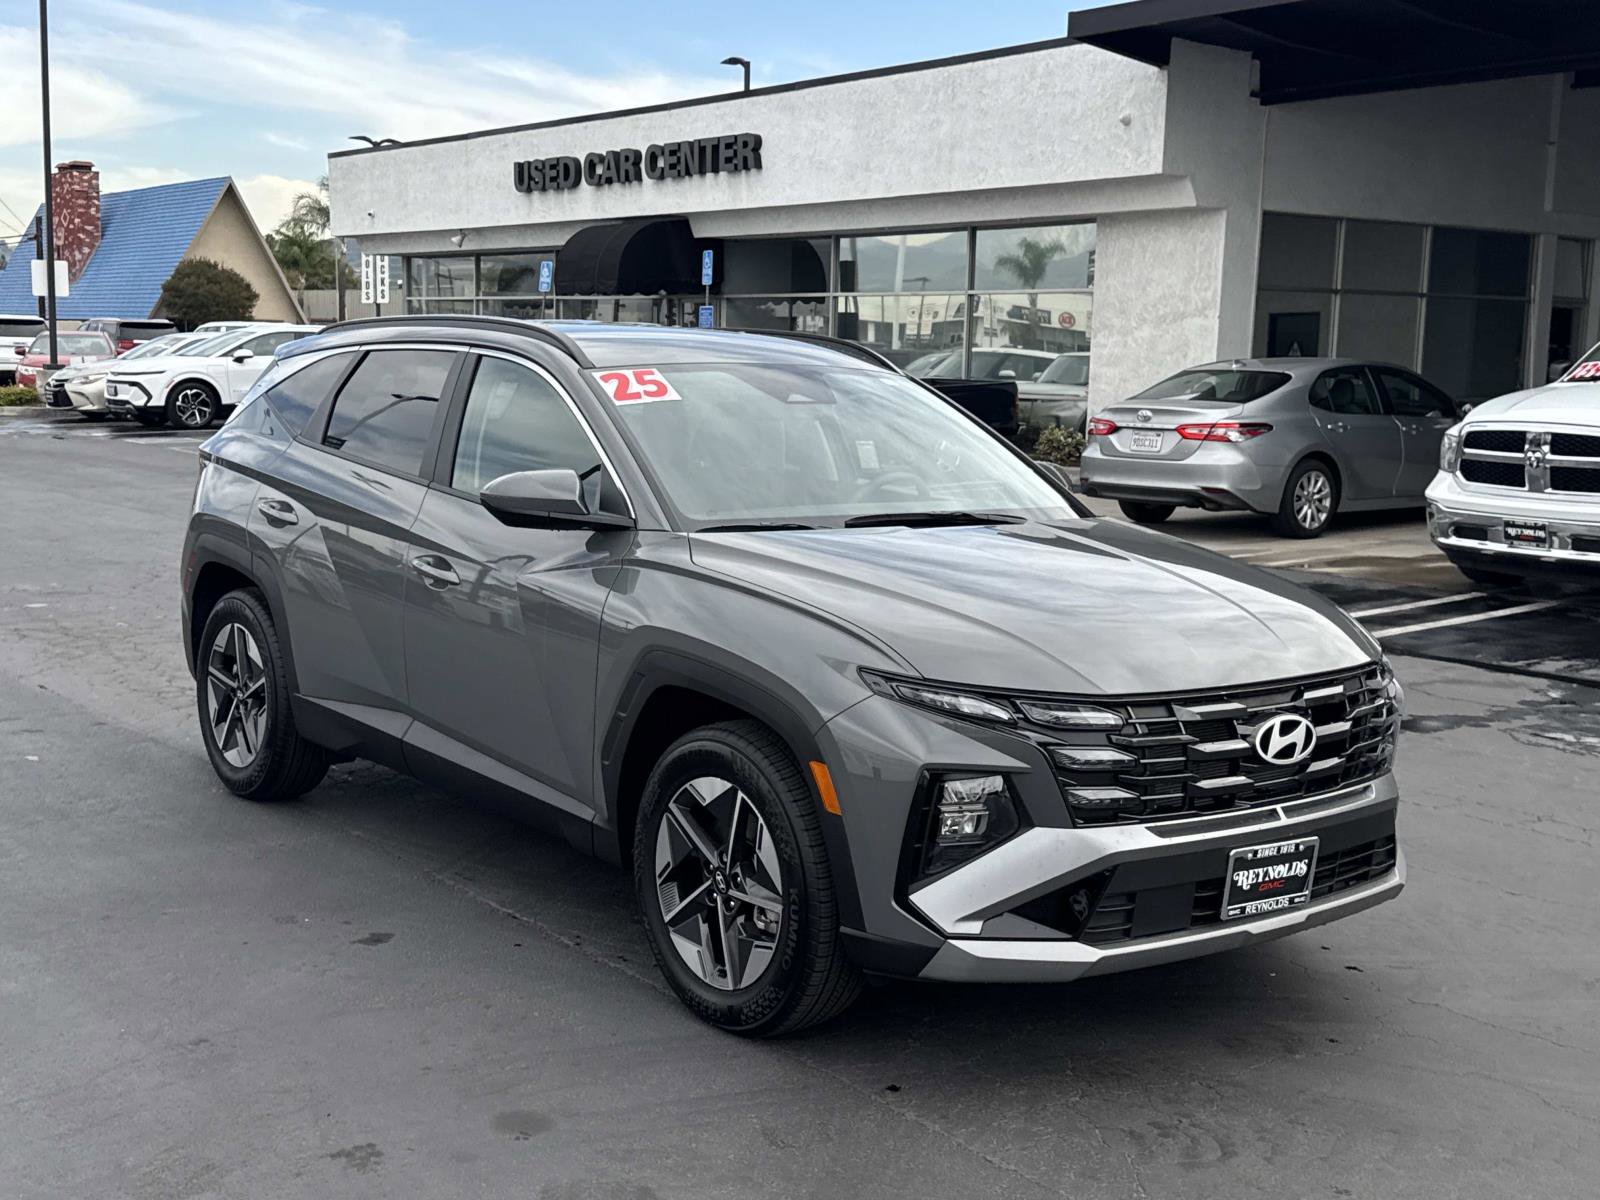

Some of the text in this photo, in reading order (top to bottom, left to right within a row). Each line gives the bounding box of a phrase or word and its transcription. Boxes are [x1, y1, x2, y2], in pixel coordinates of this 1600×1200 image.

[514, 132, 763, 193] USED CAR CENTER
[600, 369, 668, 402] 25
[1257, 847, 1278, 858] SINCE
[1233, 859, 1308, 890] REYNOLDS
[1259, 880, 1285, 891] GMC
[1245, 898, 1290, 915] REYNOLDS
[782, 888, 799, 970] KUMHO
